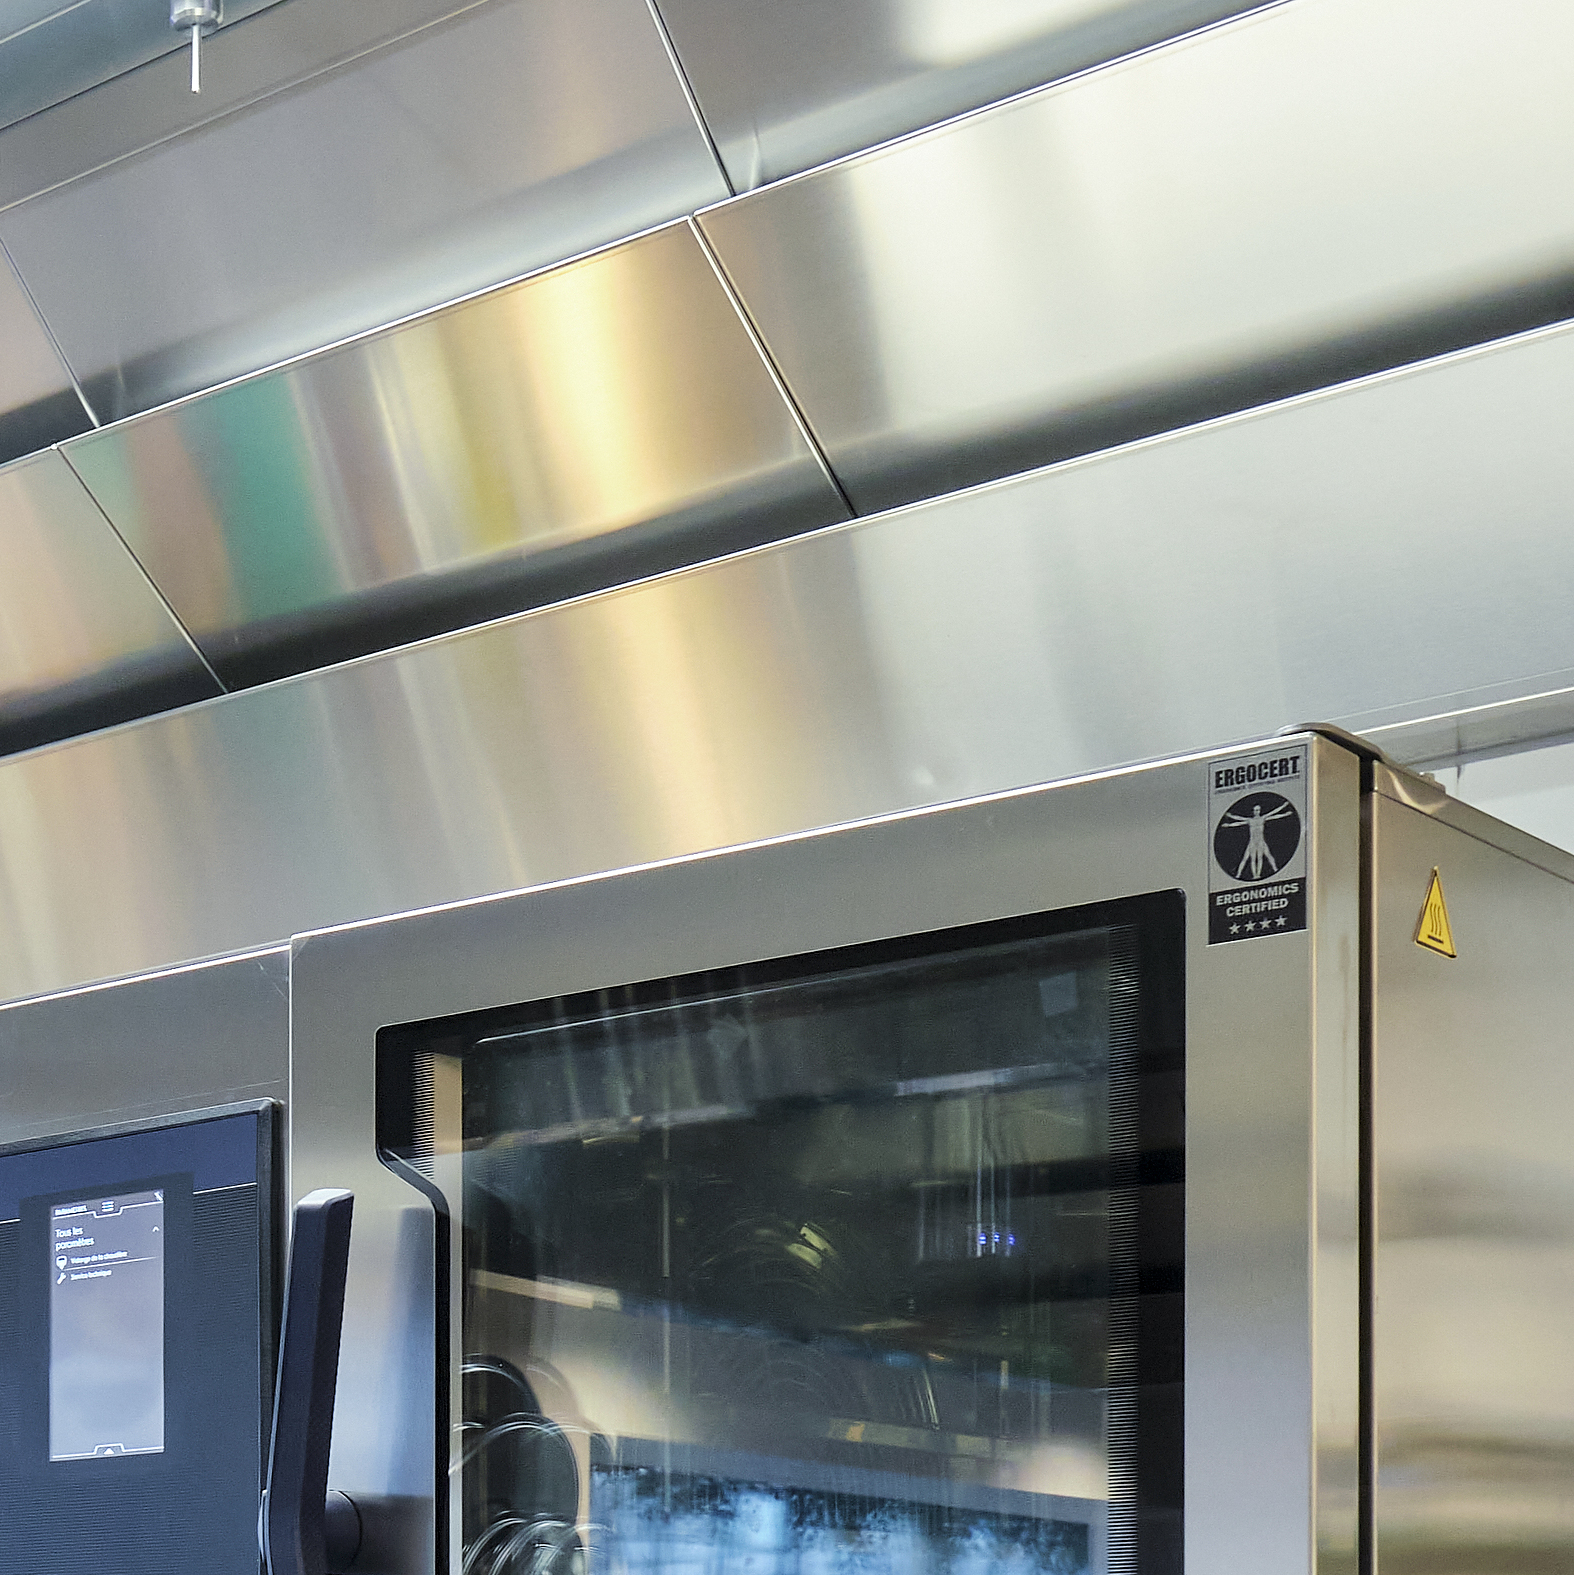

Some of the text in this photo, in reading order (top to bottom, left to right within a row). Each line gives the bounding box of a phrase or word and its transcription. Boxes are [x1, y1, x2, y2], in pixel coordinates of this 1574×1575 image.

[1214, 755, 1300, 789] ERGOCERT
[1215, 882, 1299, 906] ERGONOMICS
[1225, 898, 1289, 917] CERTIFIED
